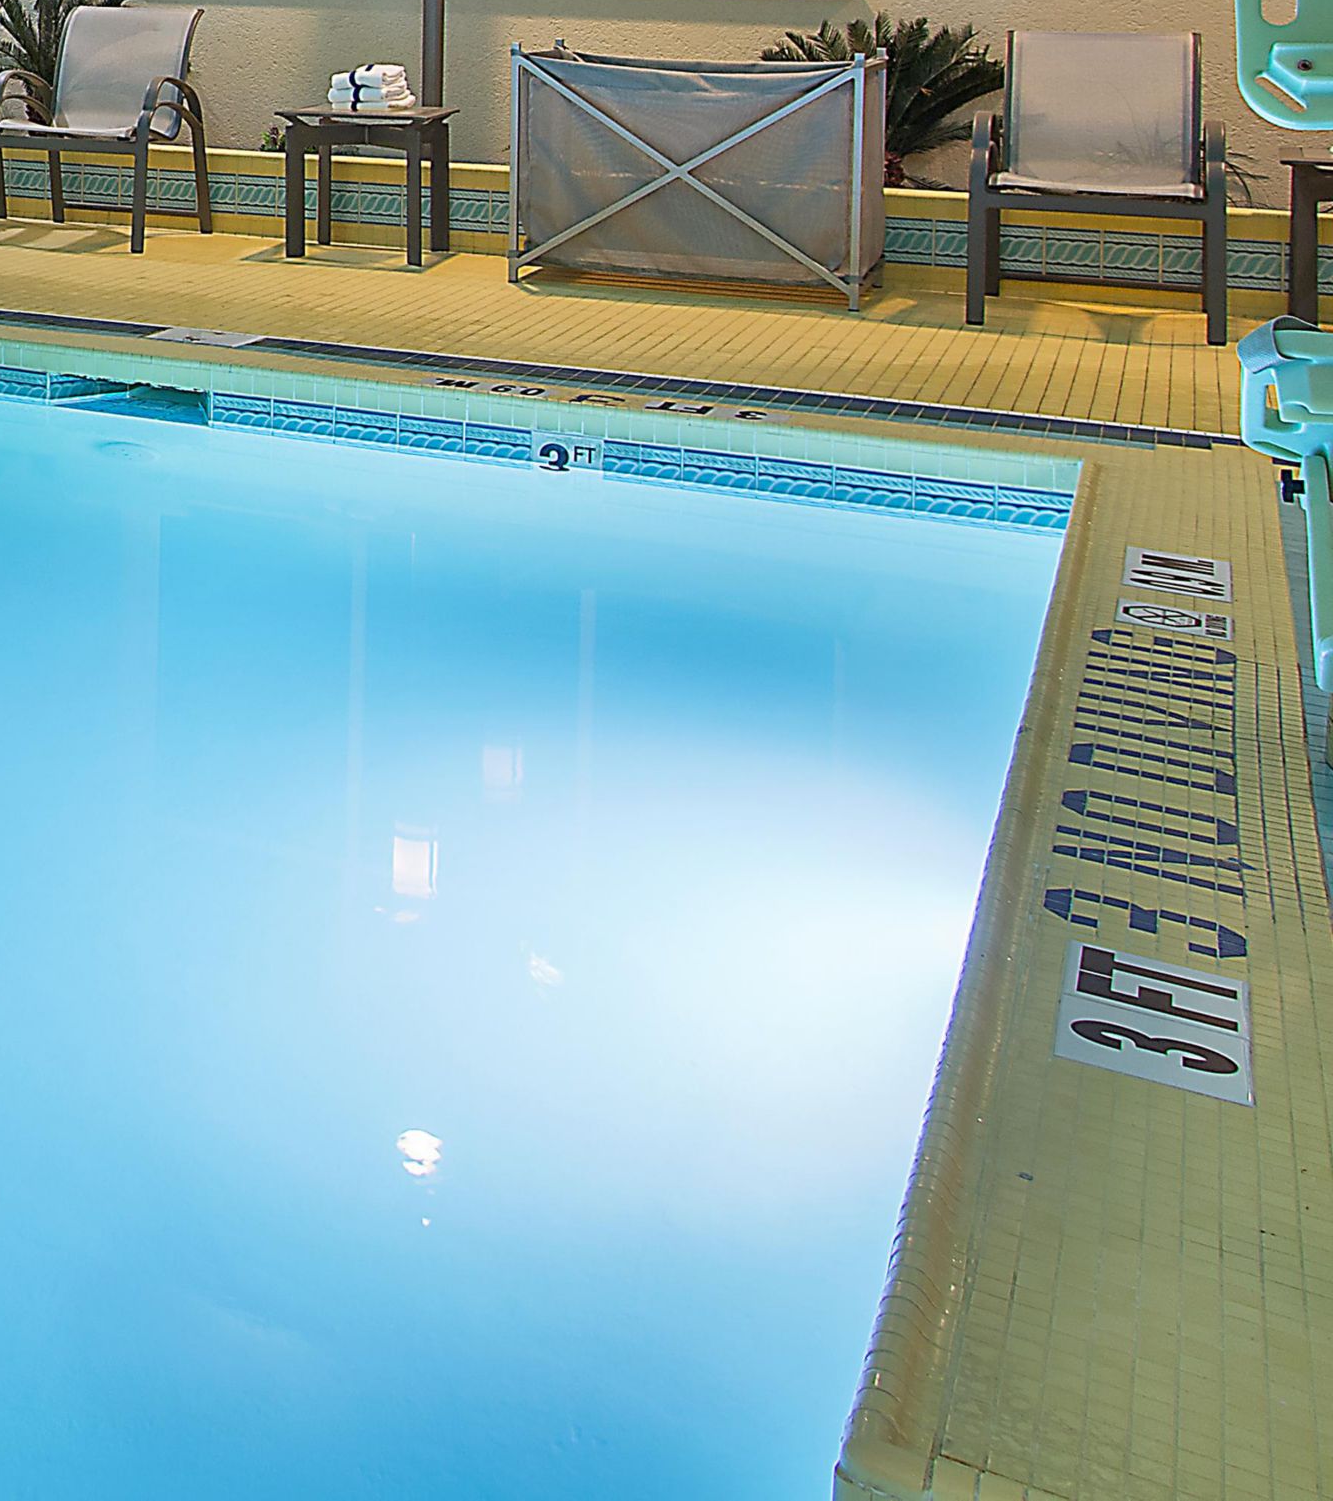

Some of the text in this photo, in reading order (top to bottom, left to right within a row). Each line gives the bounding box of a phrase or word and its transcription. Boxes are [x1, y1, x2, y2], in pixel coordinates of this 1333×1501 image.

[491, 384, 546, 396] 0.9
[645, 401, 768, 420] 3 FT
[539, 443, 596, 471] 3 FT
[1043, 629, 1247, 958] 3 NO DIVING
[1071, 946, 1239, 1074] 3 FT
